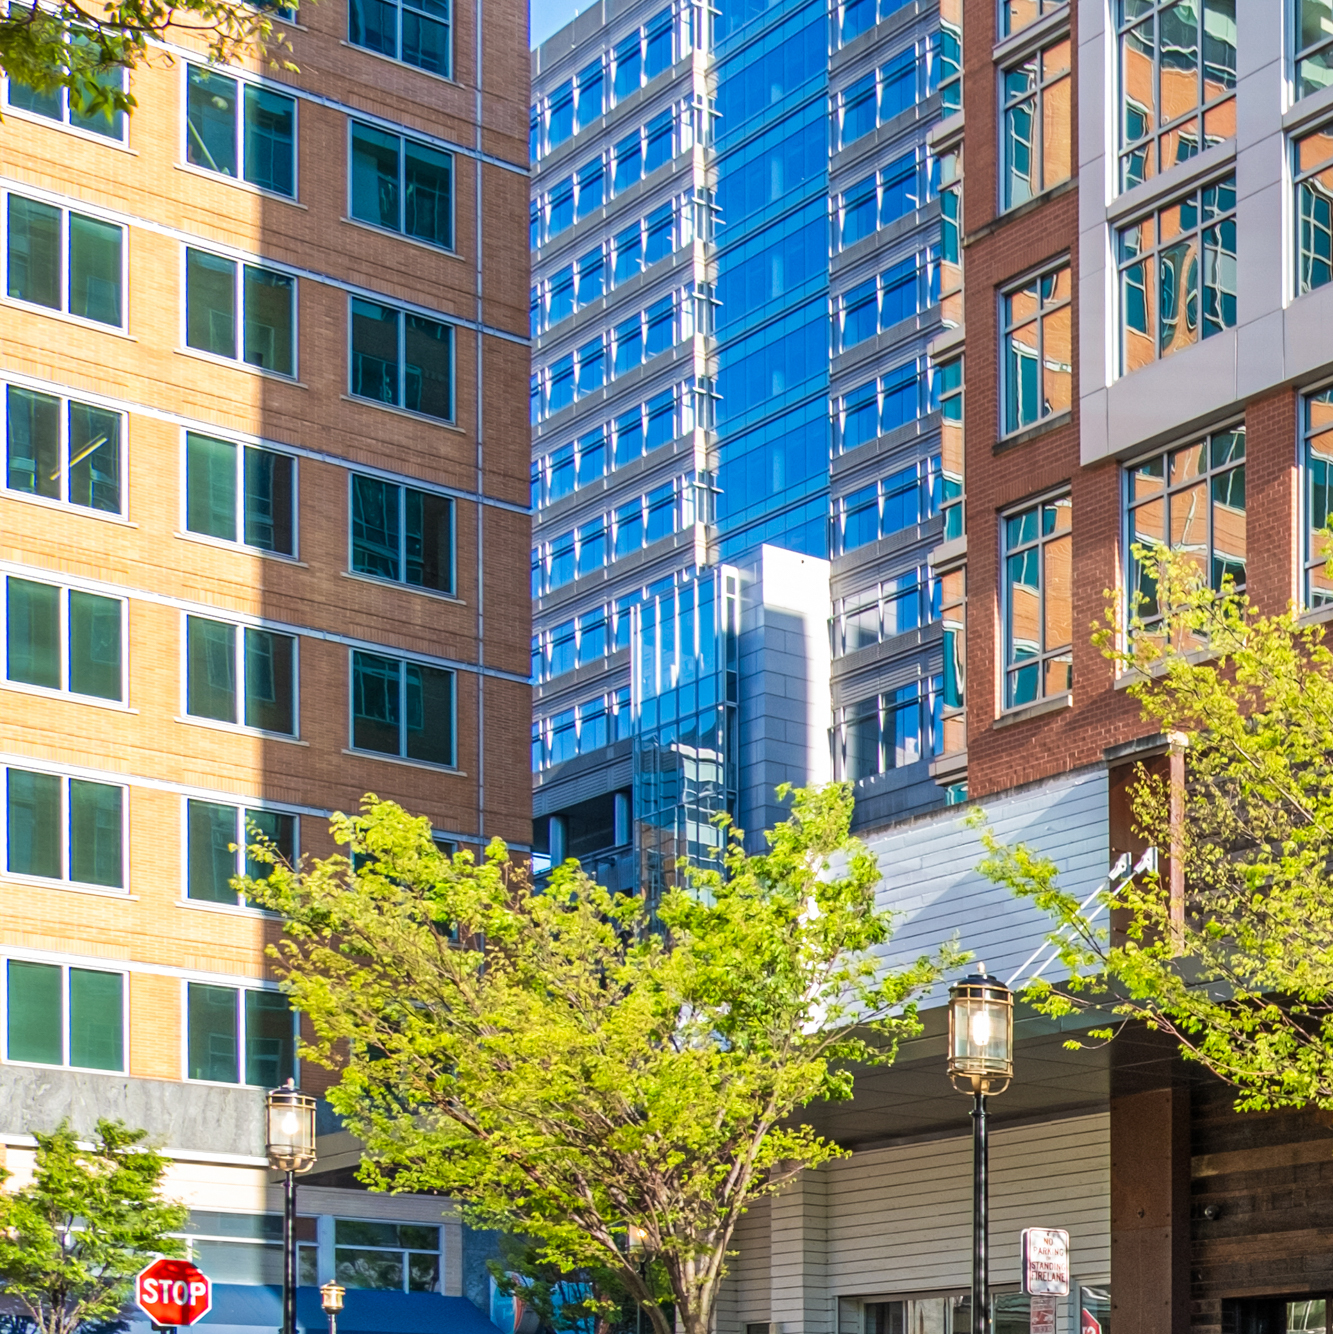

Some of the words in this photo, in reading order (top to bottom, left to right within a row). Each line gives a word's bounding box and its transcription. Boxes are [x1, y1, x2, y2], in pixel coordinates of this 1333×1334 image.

[1043, 1237, 1054, 1246] NO
[1033, 1246, 1064, 1257] PARKING
[1031, 1261, 1066, 1272] STANDING
[141, 1278, 207, 1306] STOP
